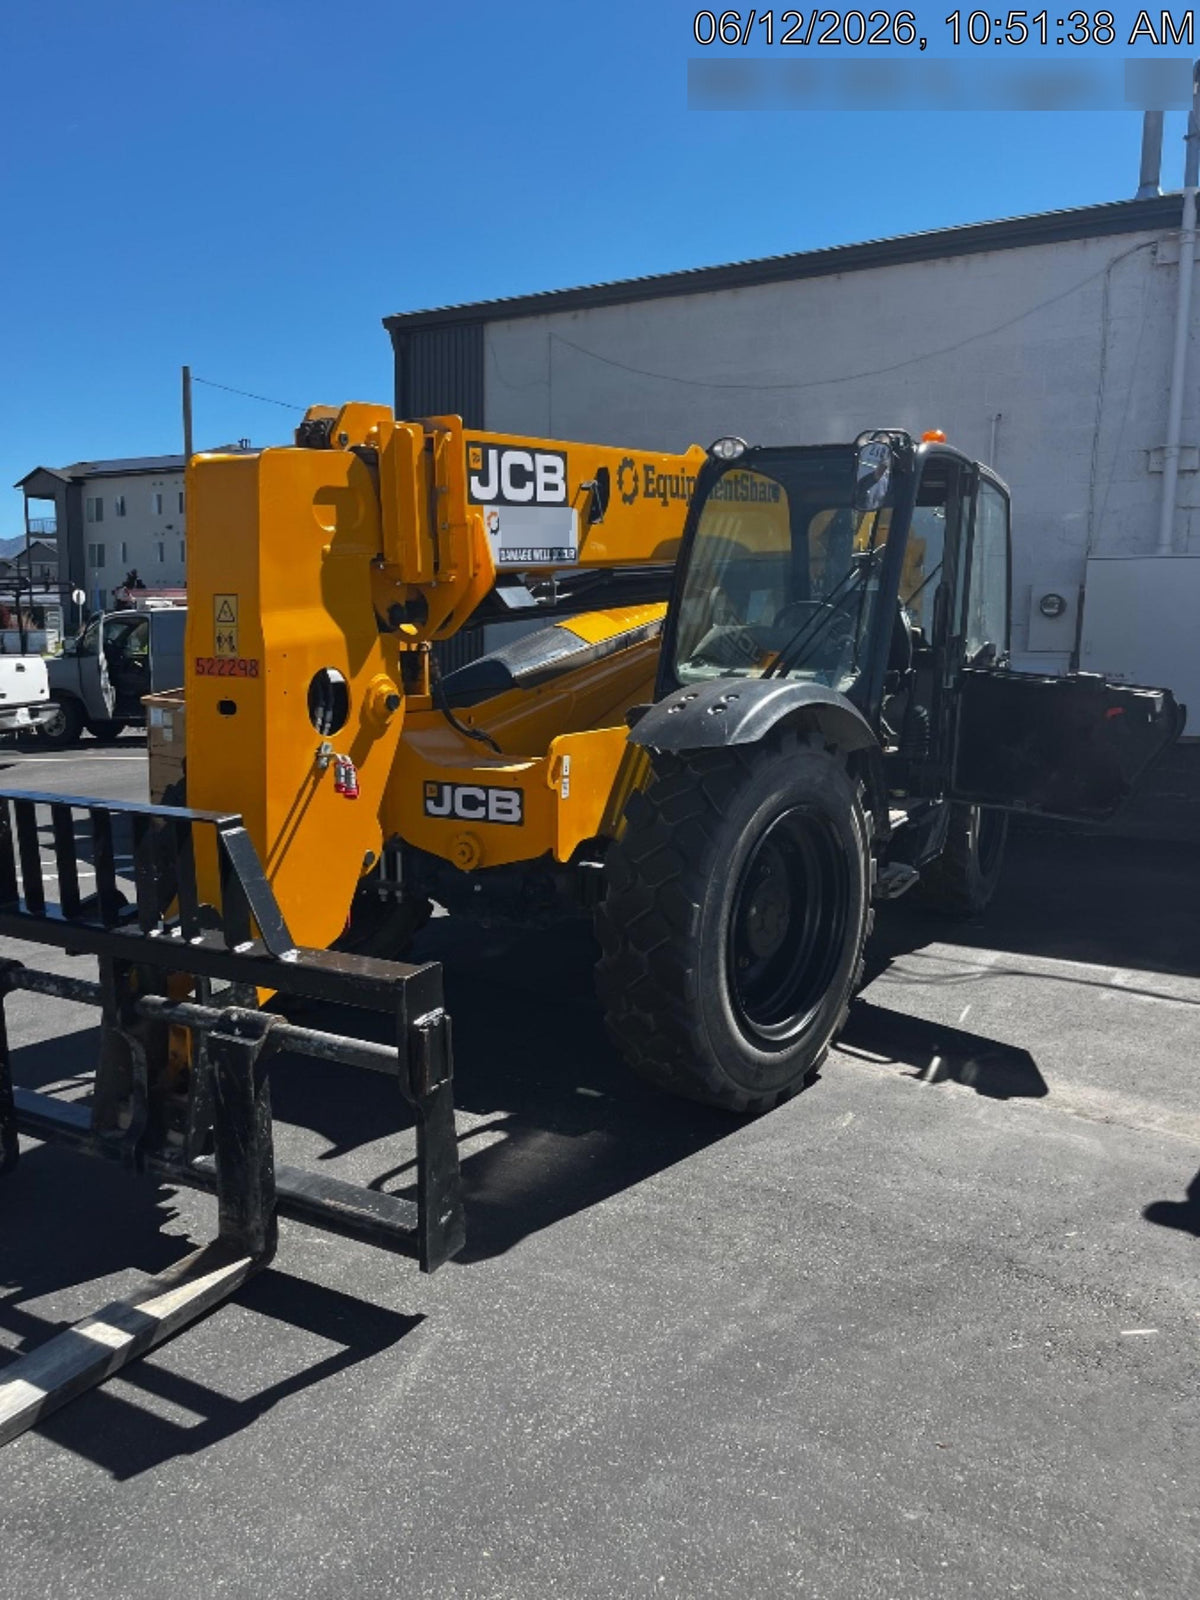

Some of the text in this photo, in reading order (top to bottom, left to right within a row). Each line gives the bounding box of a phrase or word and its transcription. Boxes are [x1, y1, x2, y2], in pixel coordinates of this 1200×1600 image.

[470, 449, 566, 502] JCB
[643, 463, 780, 507] EquipentShare
[196, 657, 258, 677] 522298
[426, 785, 522, 822] JCB
